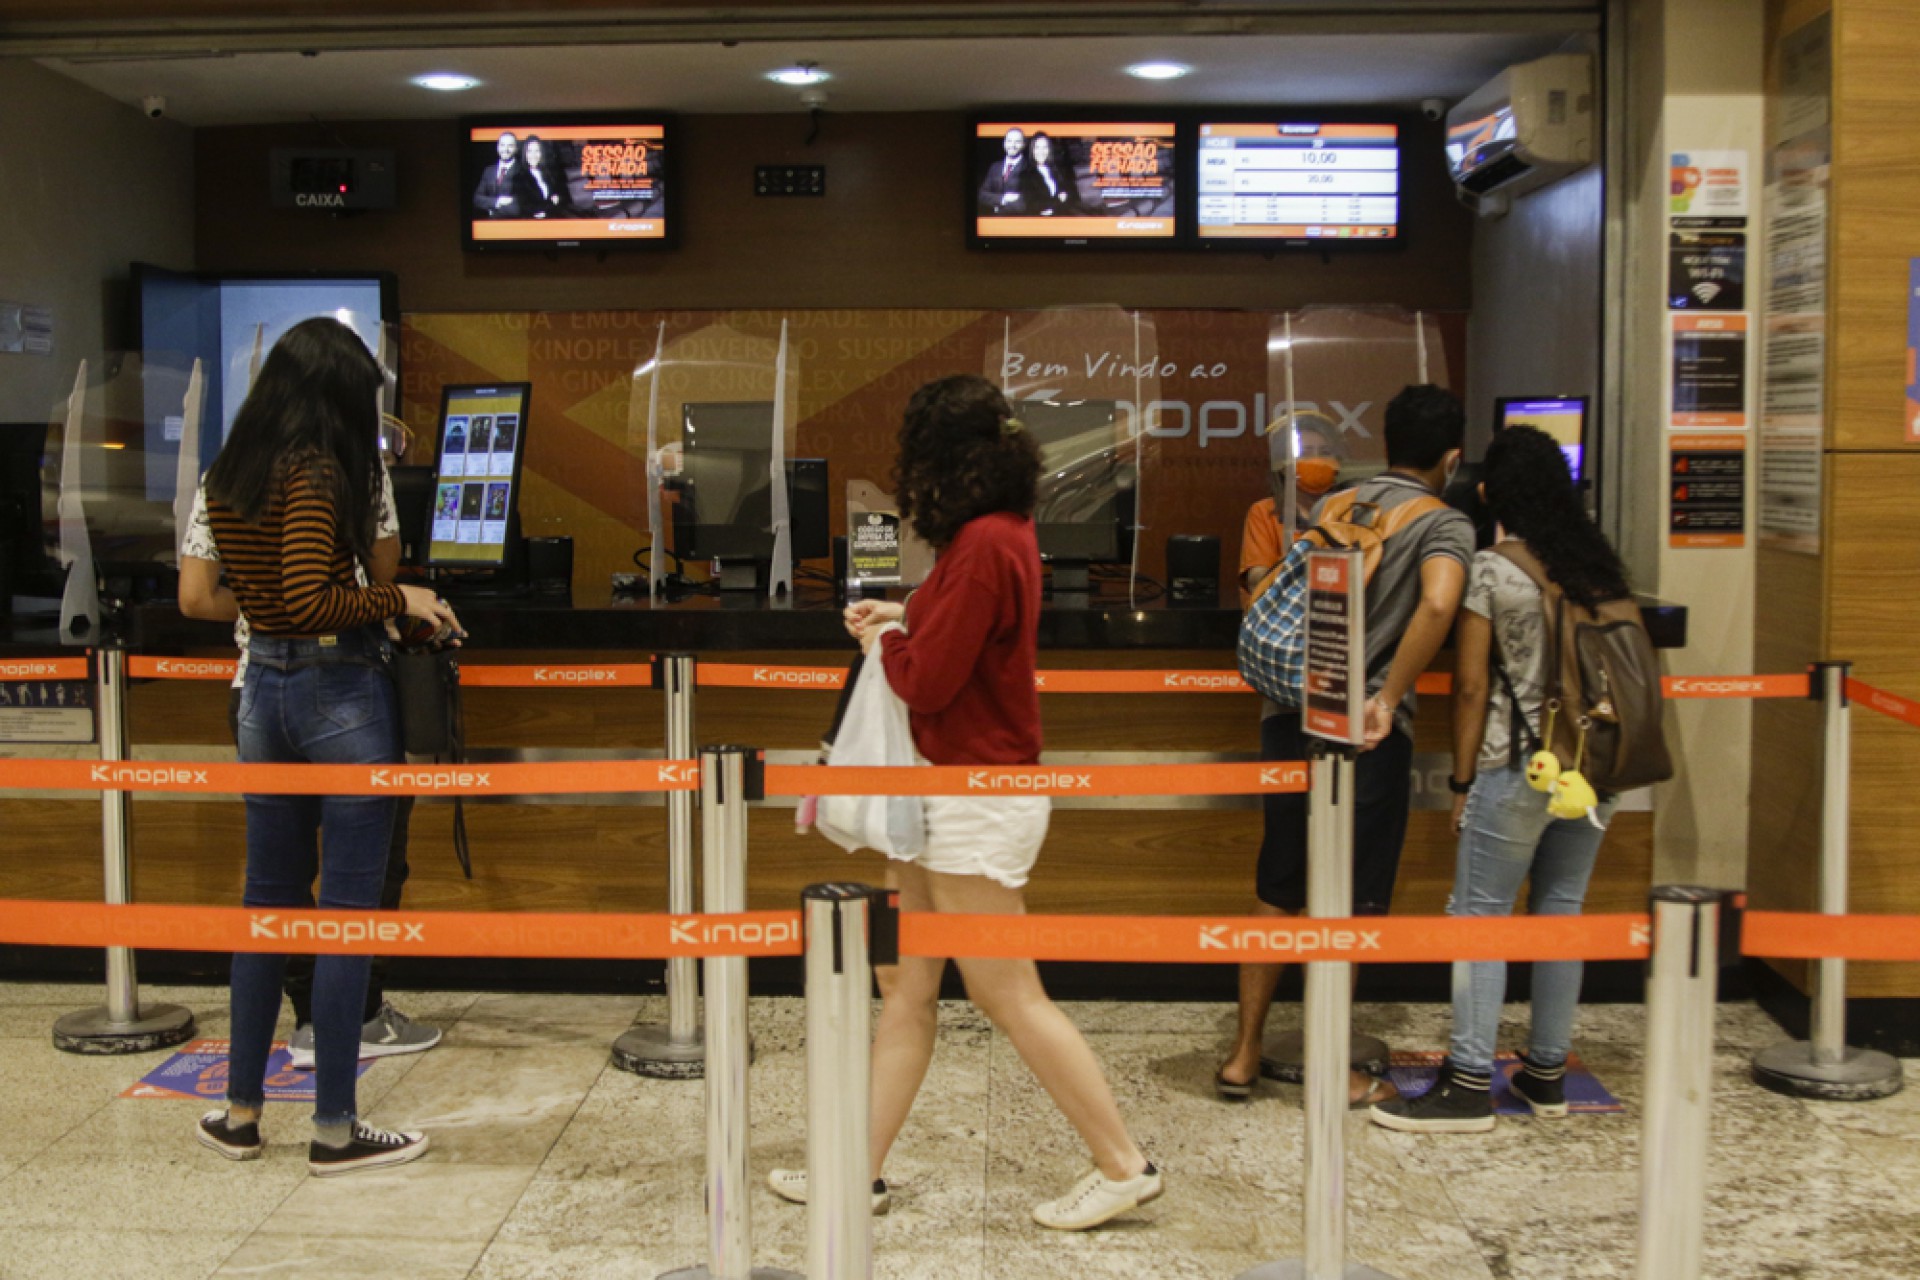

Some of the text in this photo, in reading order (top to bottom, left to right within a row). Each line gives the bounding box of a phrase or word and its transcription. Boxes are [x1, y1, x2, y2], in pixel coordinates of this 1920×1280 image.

[1301, 153, 1336, 165] 10,00
[296, 193, 344, 207] CAIXA
[712, 312, 868, 329] REALDADE
[1000, 351, 1228, 379] Bem Vindo ao
[156, 661, 235, 675] Kinoplex
[533, 667, 617, 684] Kinoplex
[753, 667, 840, 686] Kinoplex
[1164, 672, 1250, 690] Kinople
[1671, 679, 1764, 698] Kinoplex
[90, 763, 208, 787] Kinoplex
[370, 768, 490, 790] Kinoplex
[967, 769, 1092, 791] Kinoplex
[249, 913, 425, 946] Kinoplex
[669, 918, 798, 947] Kinopl
[1198, 923, 1381, 954] Kinoplex
